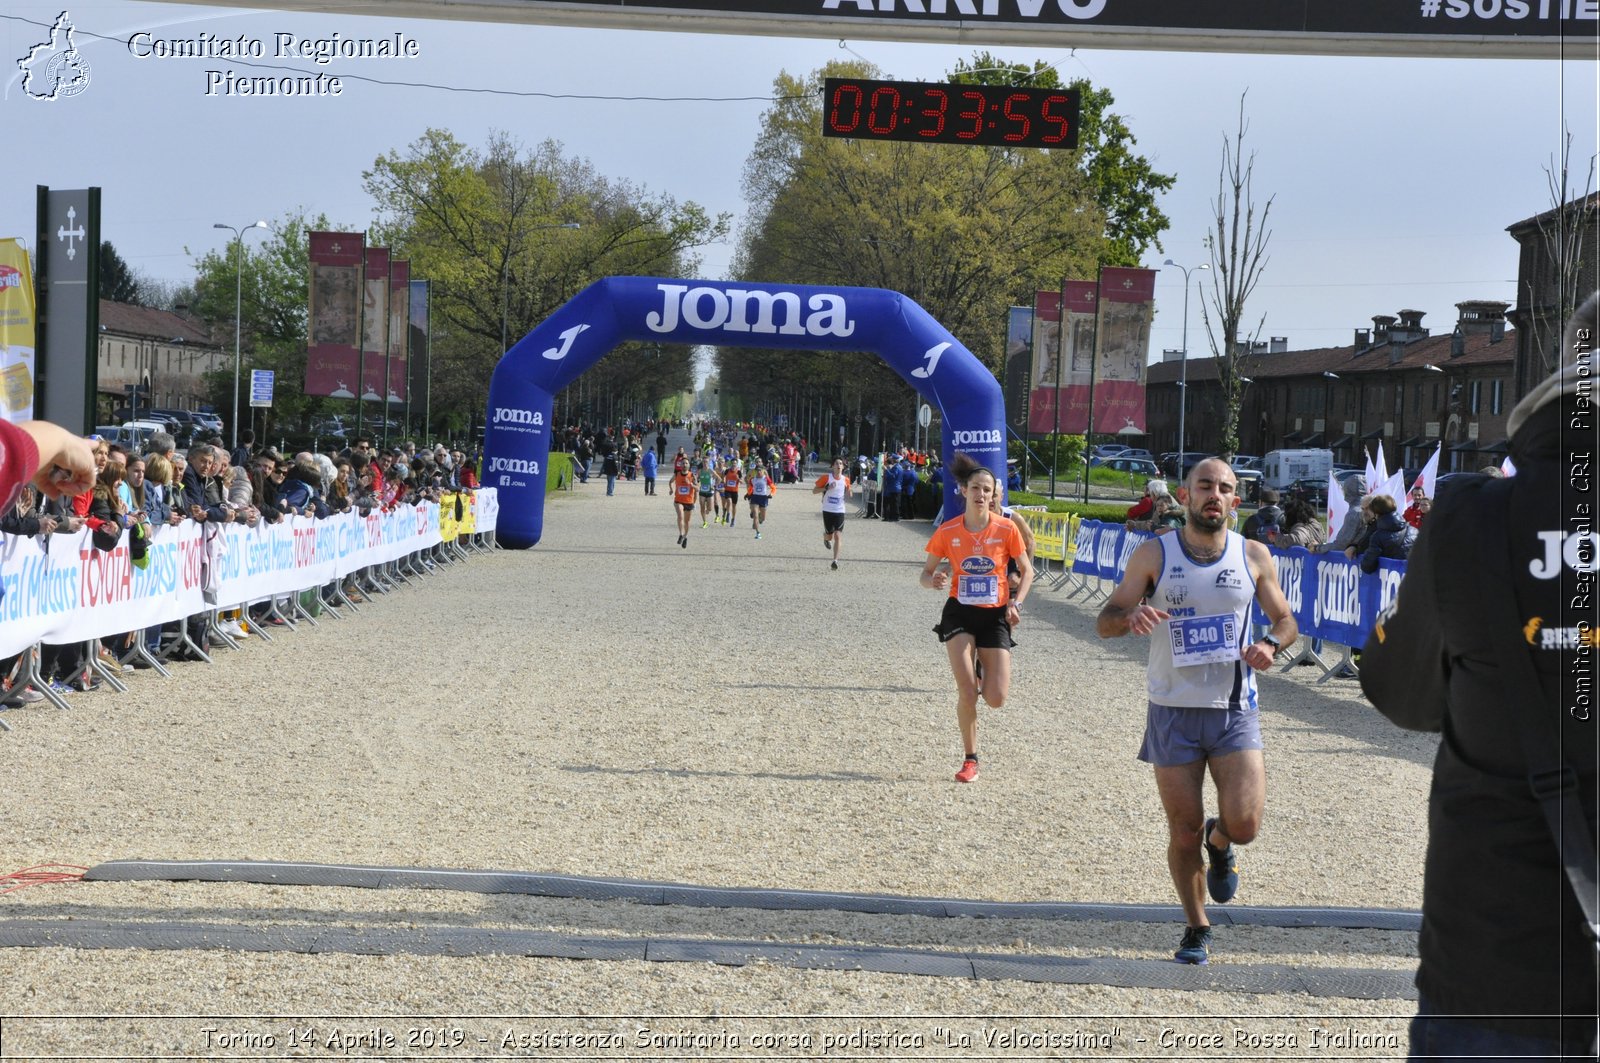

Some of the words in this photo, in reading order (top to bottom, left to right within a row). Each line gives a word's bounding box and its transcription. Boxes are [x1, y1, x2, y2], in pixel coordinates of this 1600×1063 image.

[830, 85, 1069, 142] 00:33:55
[26, 555, 77, 615] Motors
[80, 545, 131, 607] TOYOTA
[970, 582, 987, 592] 196
[1188, 626, 1218, 645] 340
